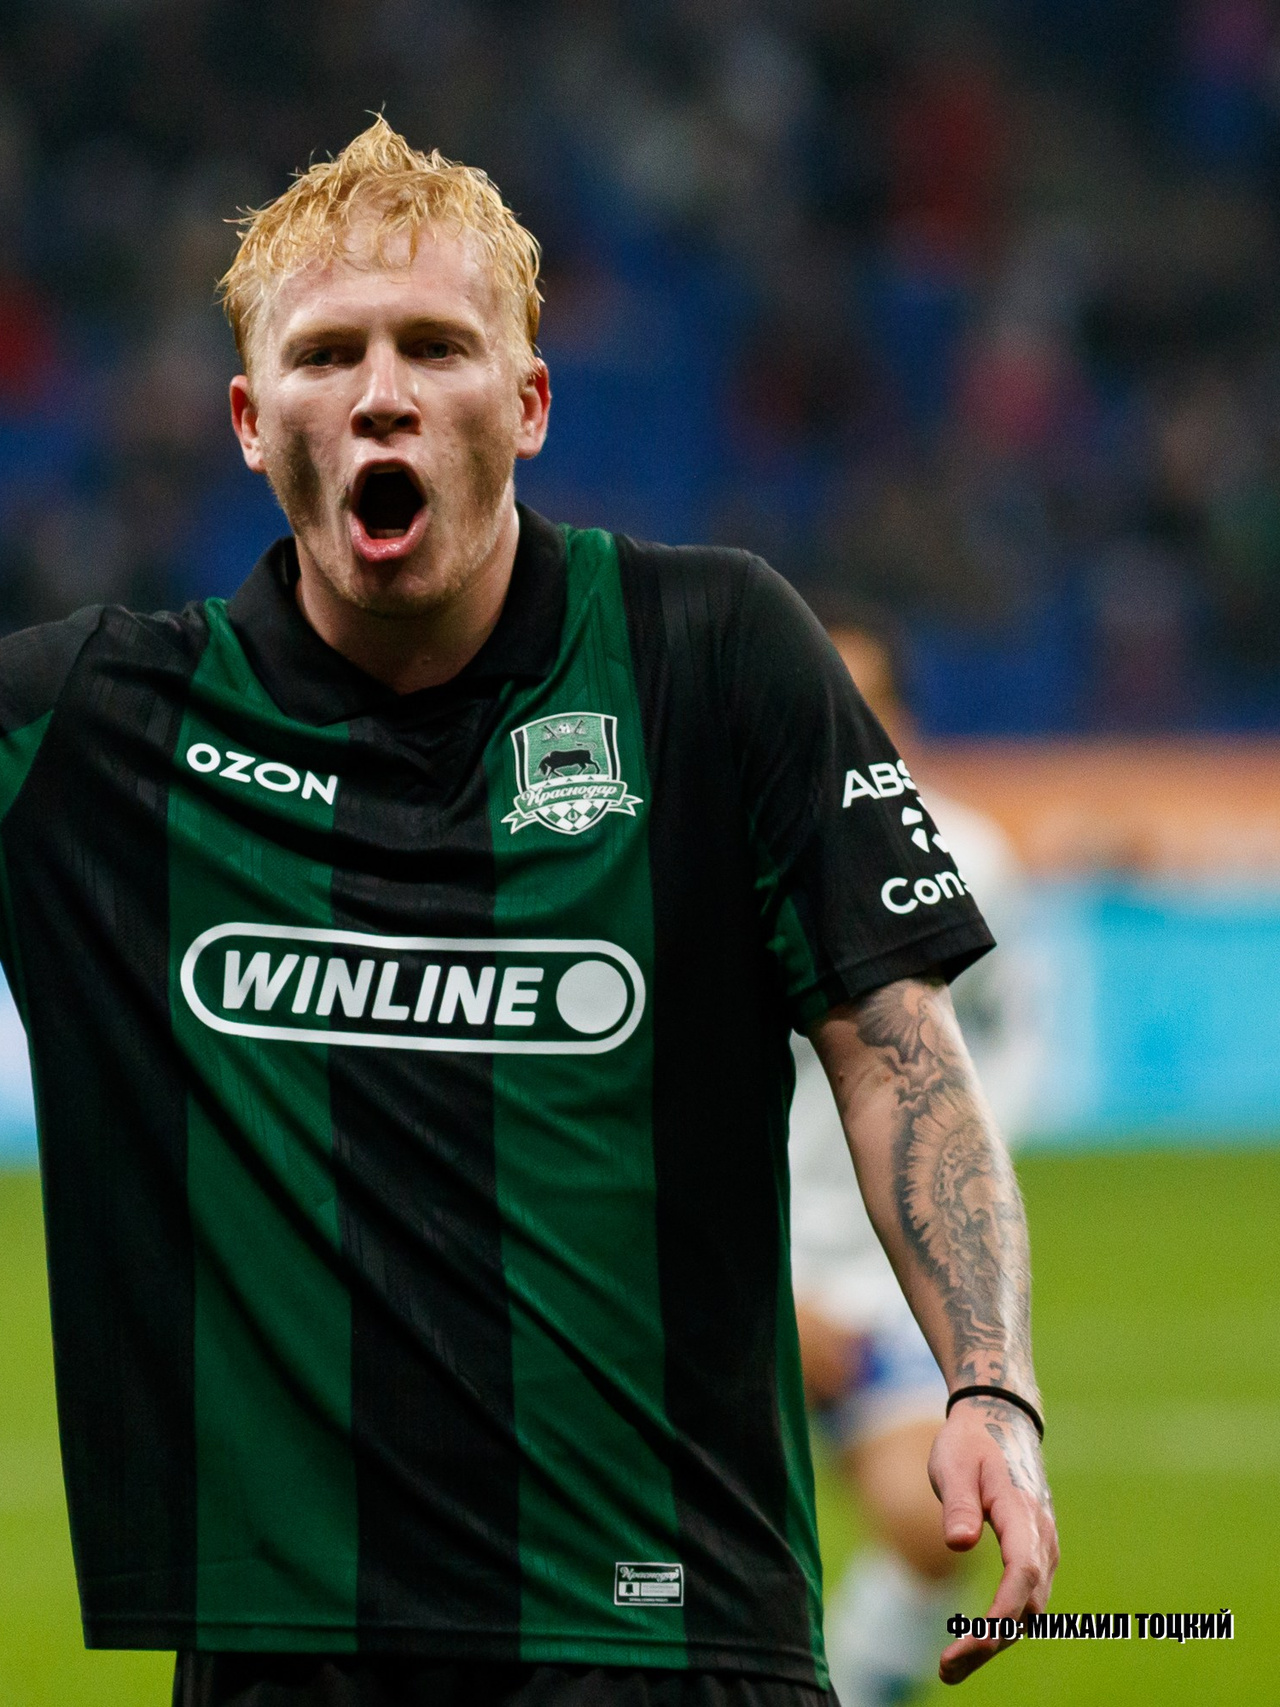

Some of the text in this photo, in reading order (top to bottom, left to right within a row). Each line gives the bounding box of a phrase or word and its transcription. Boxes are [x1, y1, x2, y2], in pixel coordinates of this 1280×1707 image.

[186, 742, 339, 805] OZON
[521, 785, 618, 807] Краснодар
[880, 870, 971, 915] Con
[222, 949, 545, 1027] WINLINE
